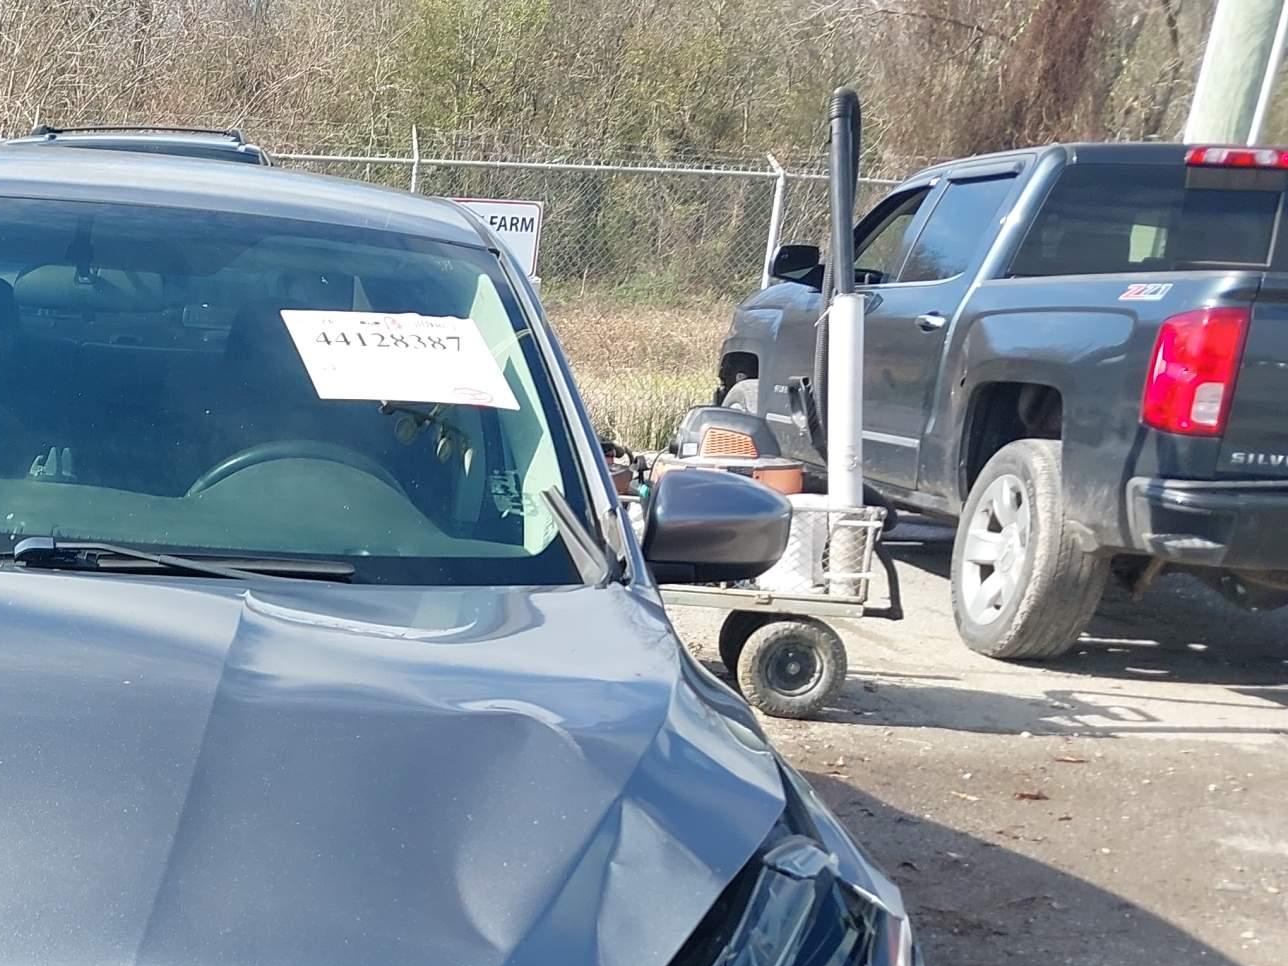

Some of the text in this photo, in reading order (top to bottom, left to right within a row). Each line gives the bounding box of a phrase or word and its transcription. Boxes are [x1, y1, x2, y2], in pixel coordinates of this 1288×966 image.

[489, 215, 535, 232] FARM
[1118, 283, 1174, 300] Z71
[315, 331, 461, 351] 44128387
[1231, 452, 1288, 466] SILV
